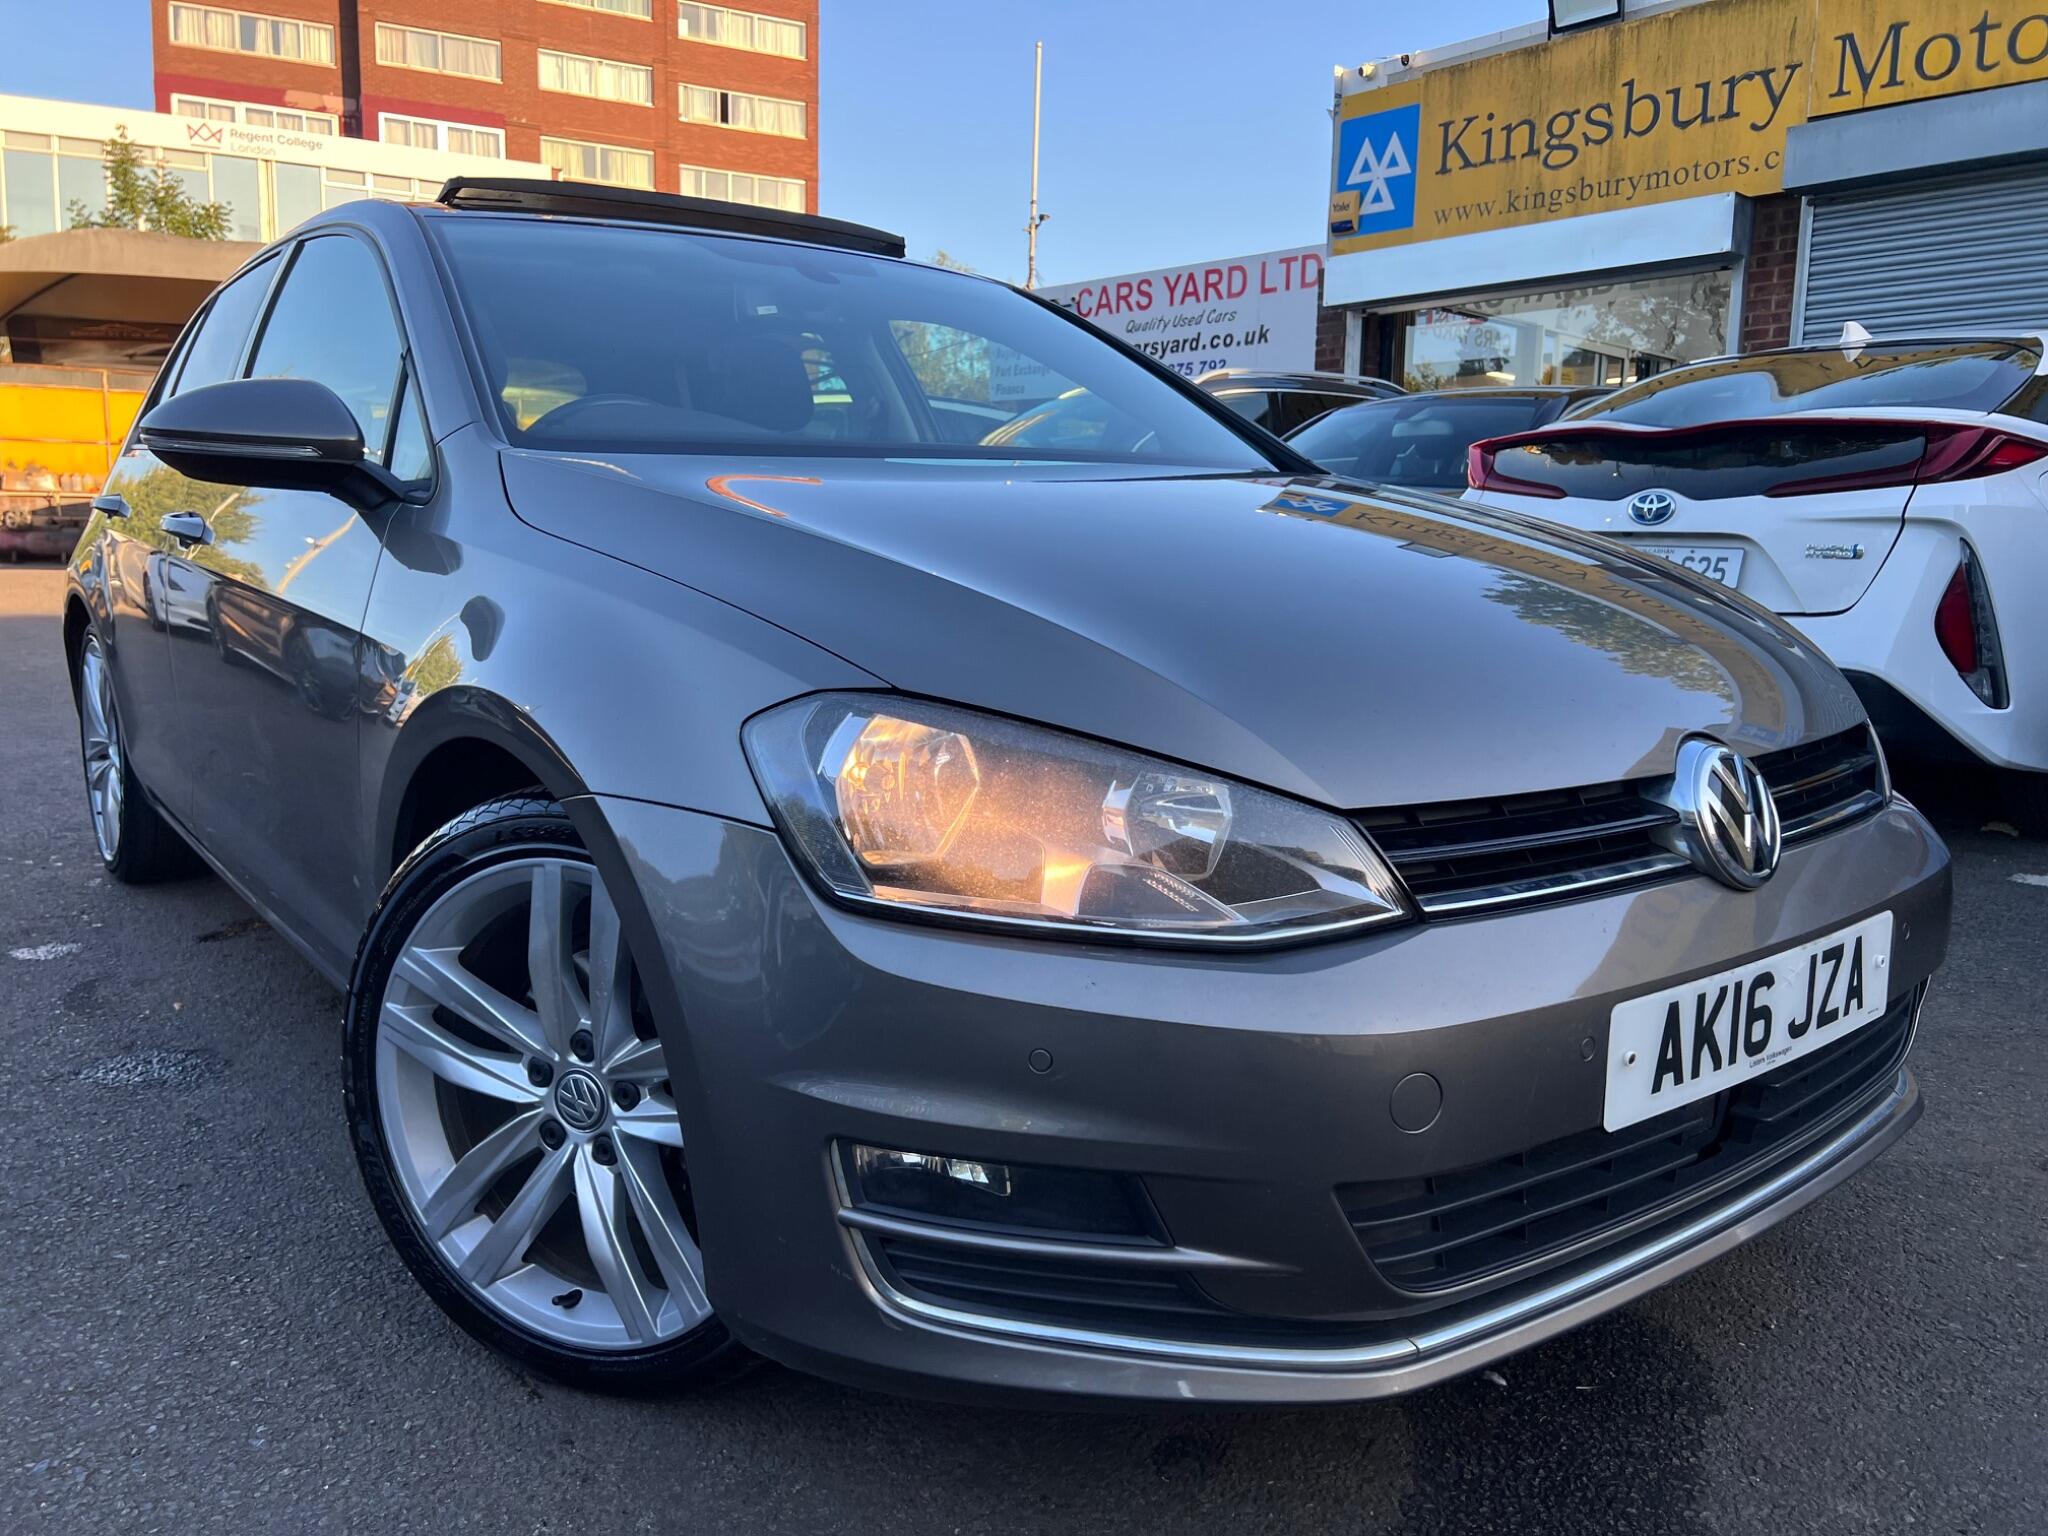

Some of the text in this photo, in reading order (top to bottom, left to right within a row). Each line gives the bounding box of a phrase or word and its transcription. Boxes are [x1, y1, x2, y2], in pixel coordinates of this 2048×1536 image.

[1436, 10, 2048, 175] Kingsbury Moto
[230, 128, 323, 151] Regent College
[1076, 252, 1324, 319] CARS YARD LTD
[1126, 308, 1237, 334] Quality Used Cars
[1651, 936, 1864, 1095] AK16 JZA
